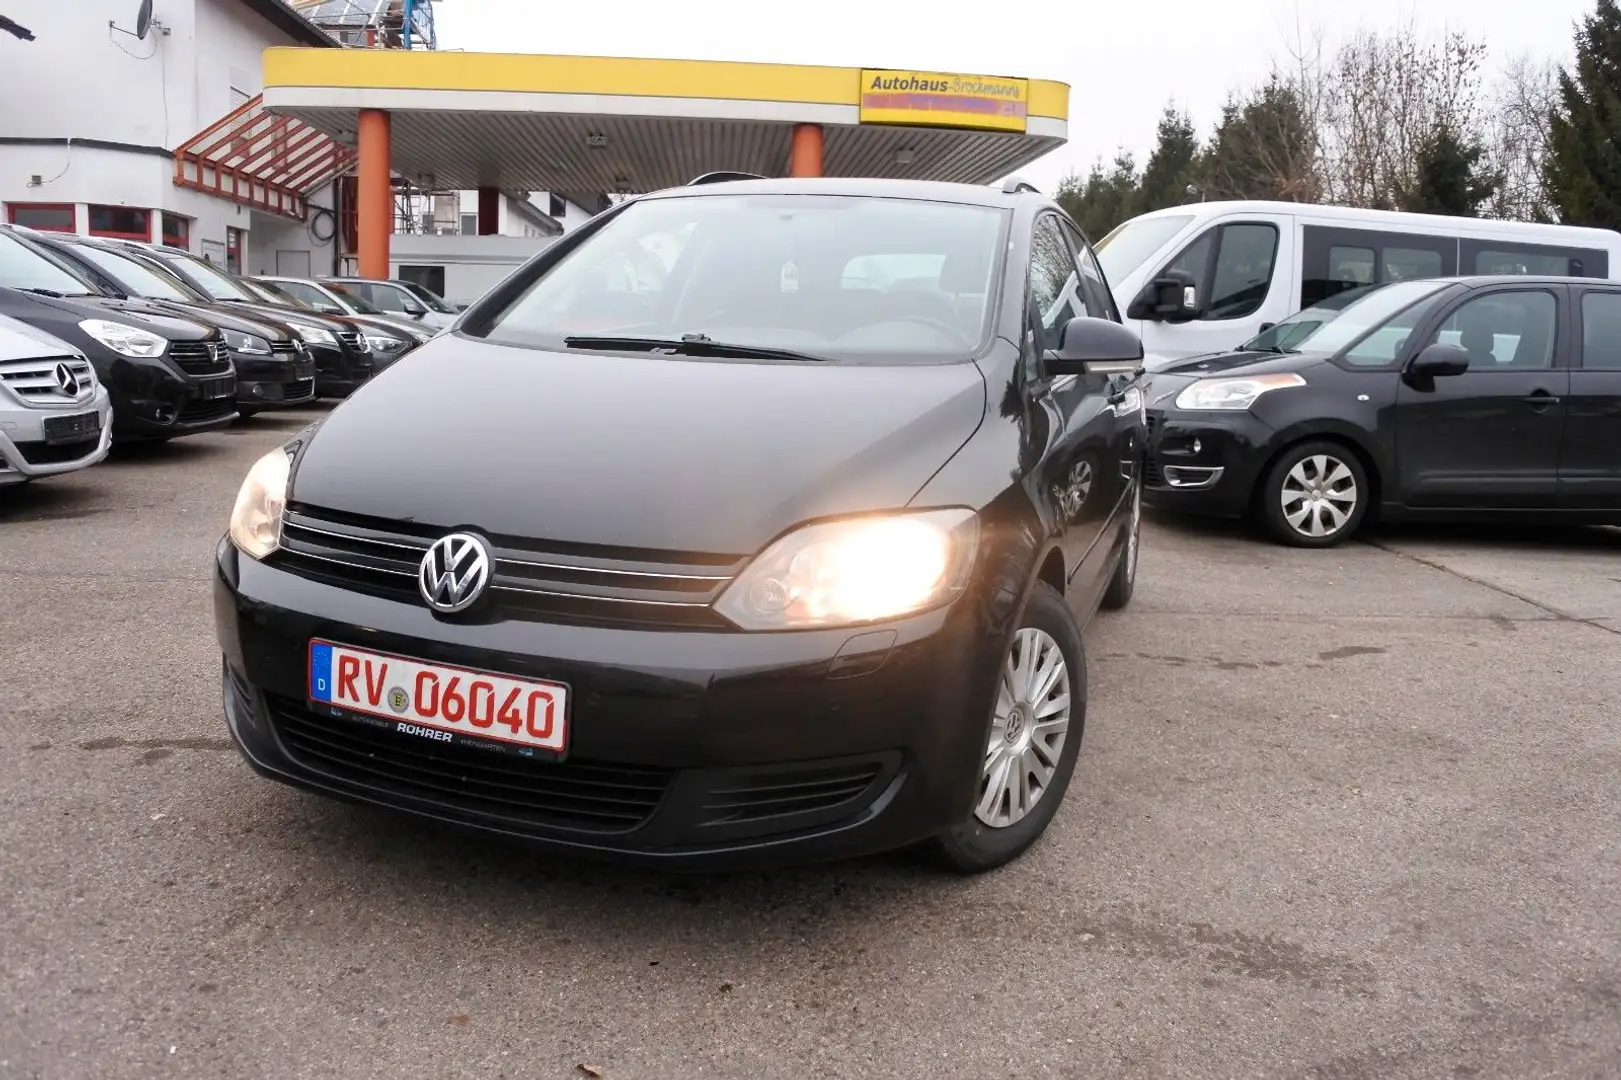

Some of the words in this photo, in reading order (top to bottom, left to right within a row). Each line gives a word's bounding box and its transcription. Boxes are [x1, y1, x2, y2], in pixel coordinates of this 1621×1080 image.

[317, 677, 327, 691] D
[337, 654, 388, 706] RV
[414, 670, 555, 739] 06040
[396, 722, 453, 743] ROHRER
